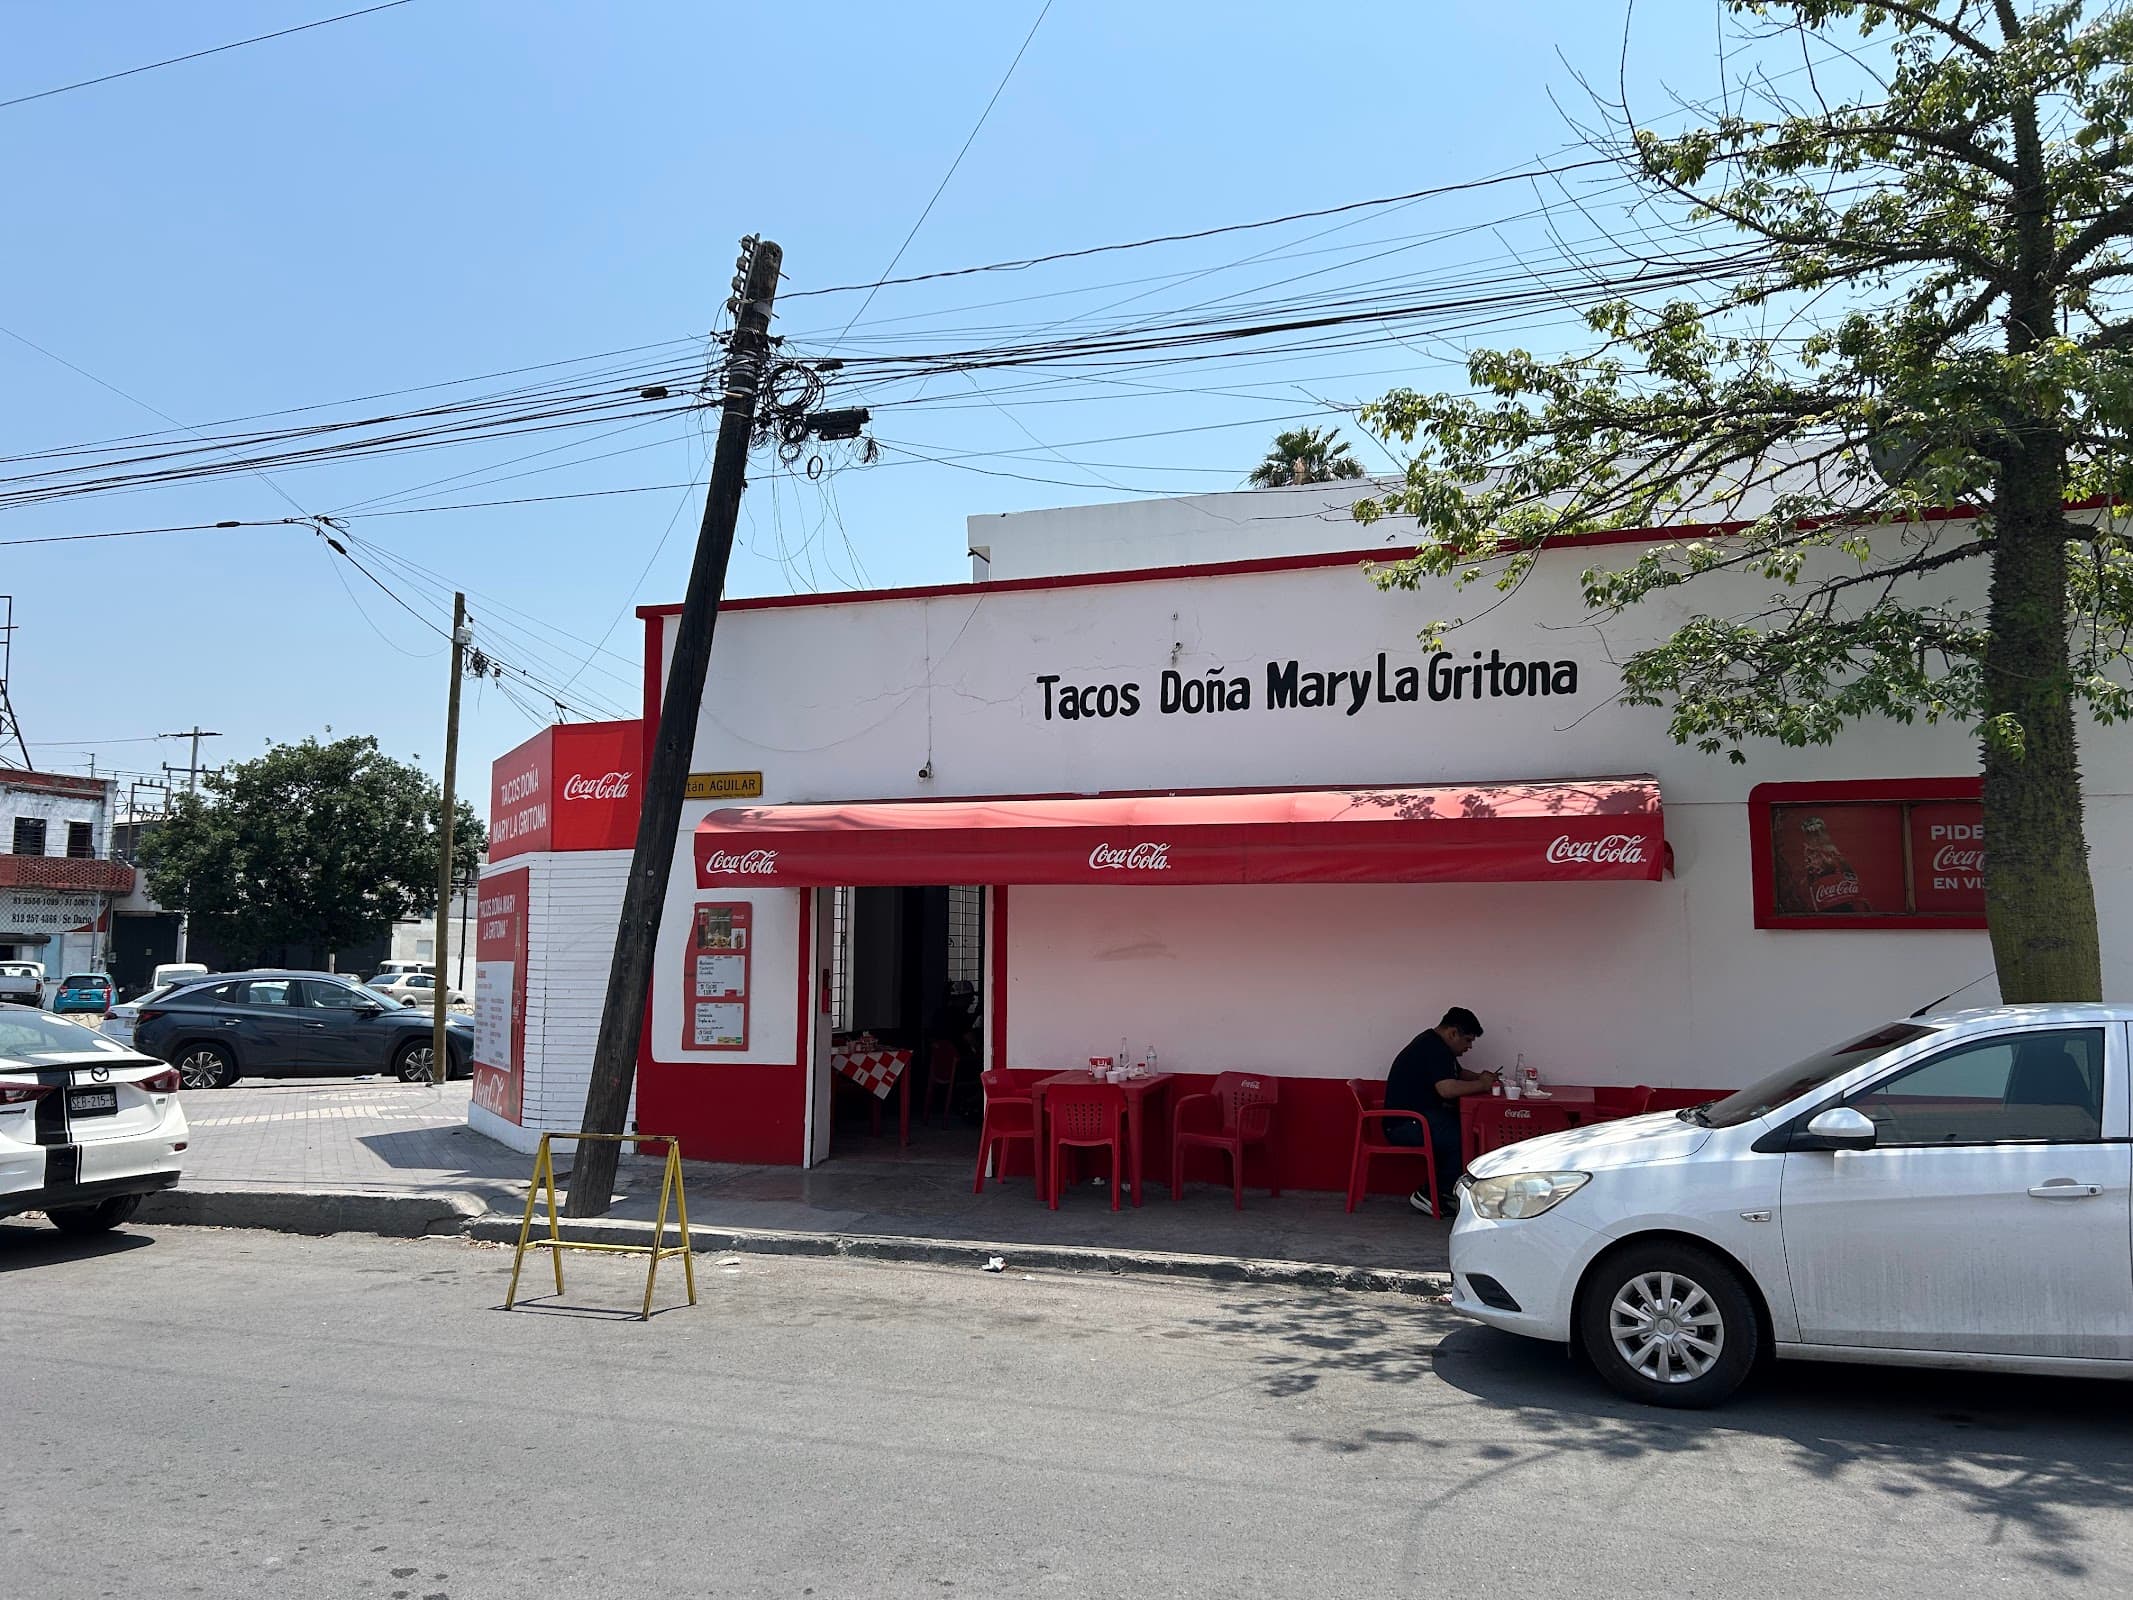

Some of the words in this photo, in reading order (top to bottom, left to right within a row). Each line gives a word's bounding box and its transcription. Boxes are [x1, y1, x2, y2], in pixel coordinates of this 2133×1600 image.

[1036, 675, 1141, 721] Tacos
[1160, 666, 1251, 714] Doña
[1266, 660, 1372, 716] Mary
[1377, 652, 1419, 703] La
[1428, 649, 1578, 702] Gritona
[501, 776, 520, 806] TACOS
[520, 763, 539, 799] DOÑA
[709, 779, 756, 792] AGUILAR
[492, 819, 509, 844] MARY
[509, 815, 518, 838] LA
[518, 802, 547, 835] GRITONA
[1930, 824, 1984, 841] PIDE
[1933, 877, 1959, 889] EN
[1962, 877, 1985, 889] VI
